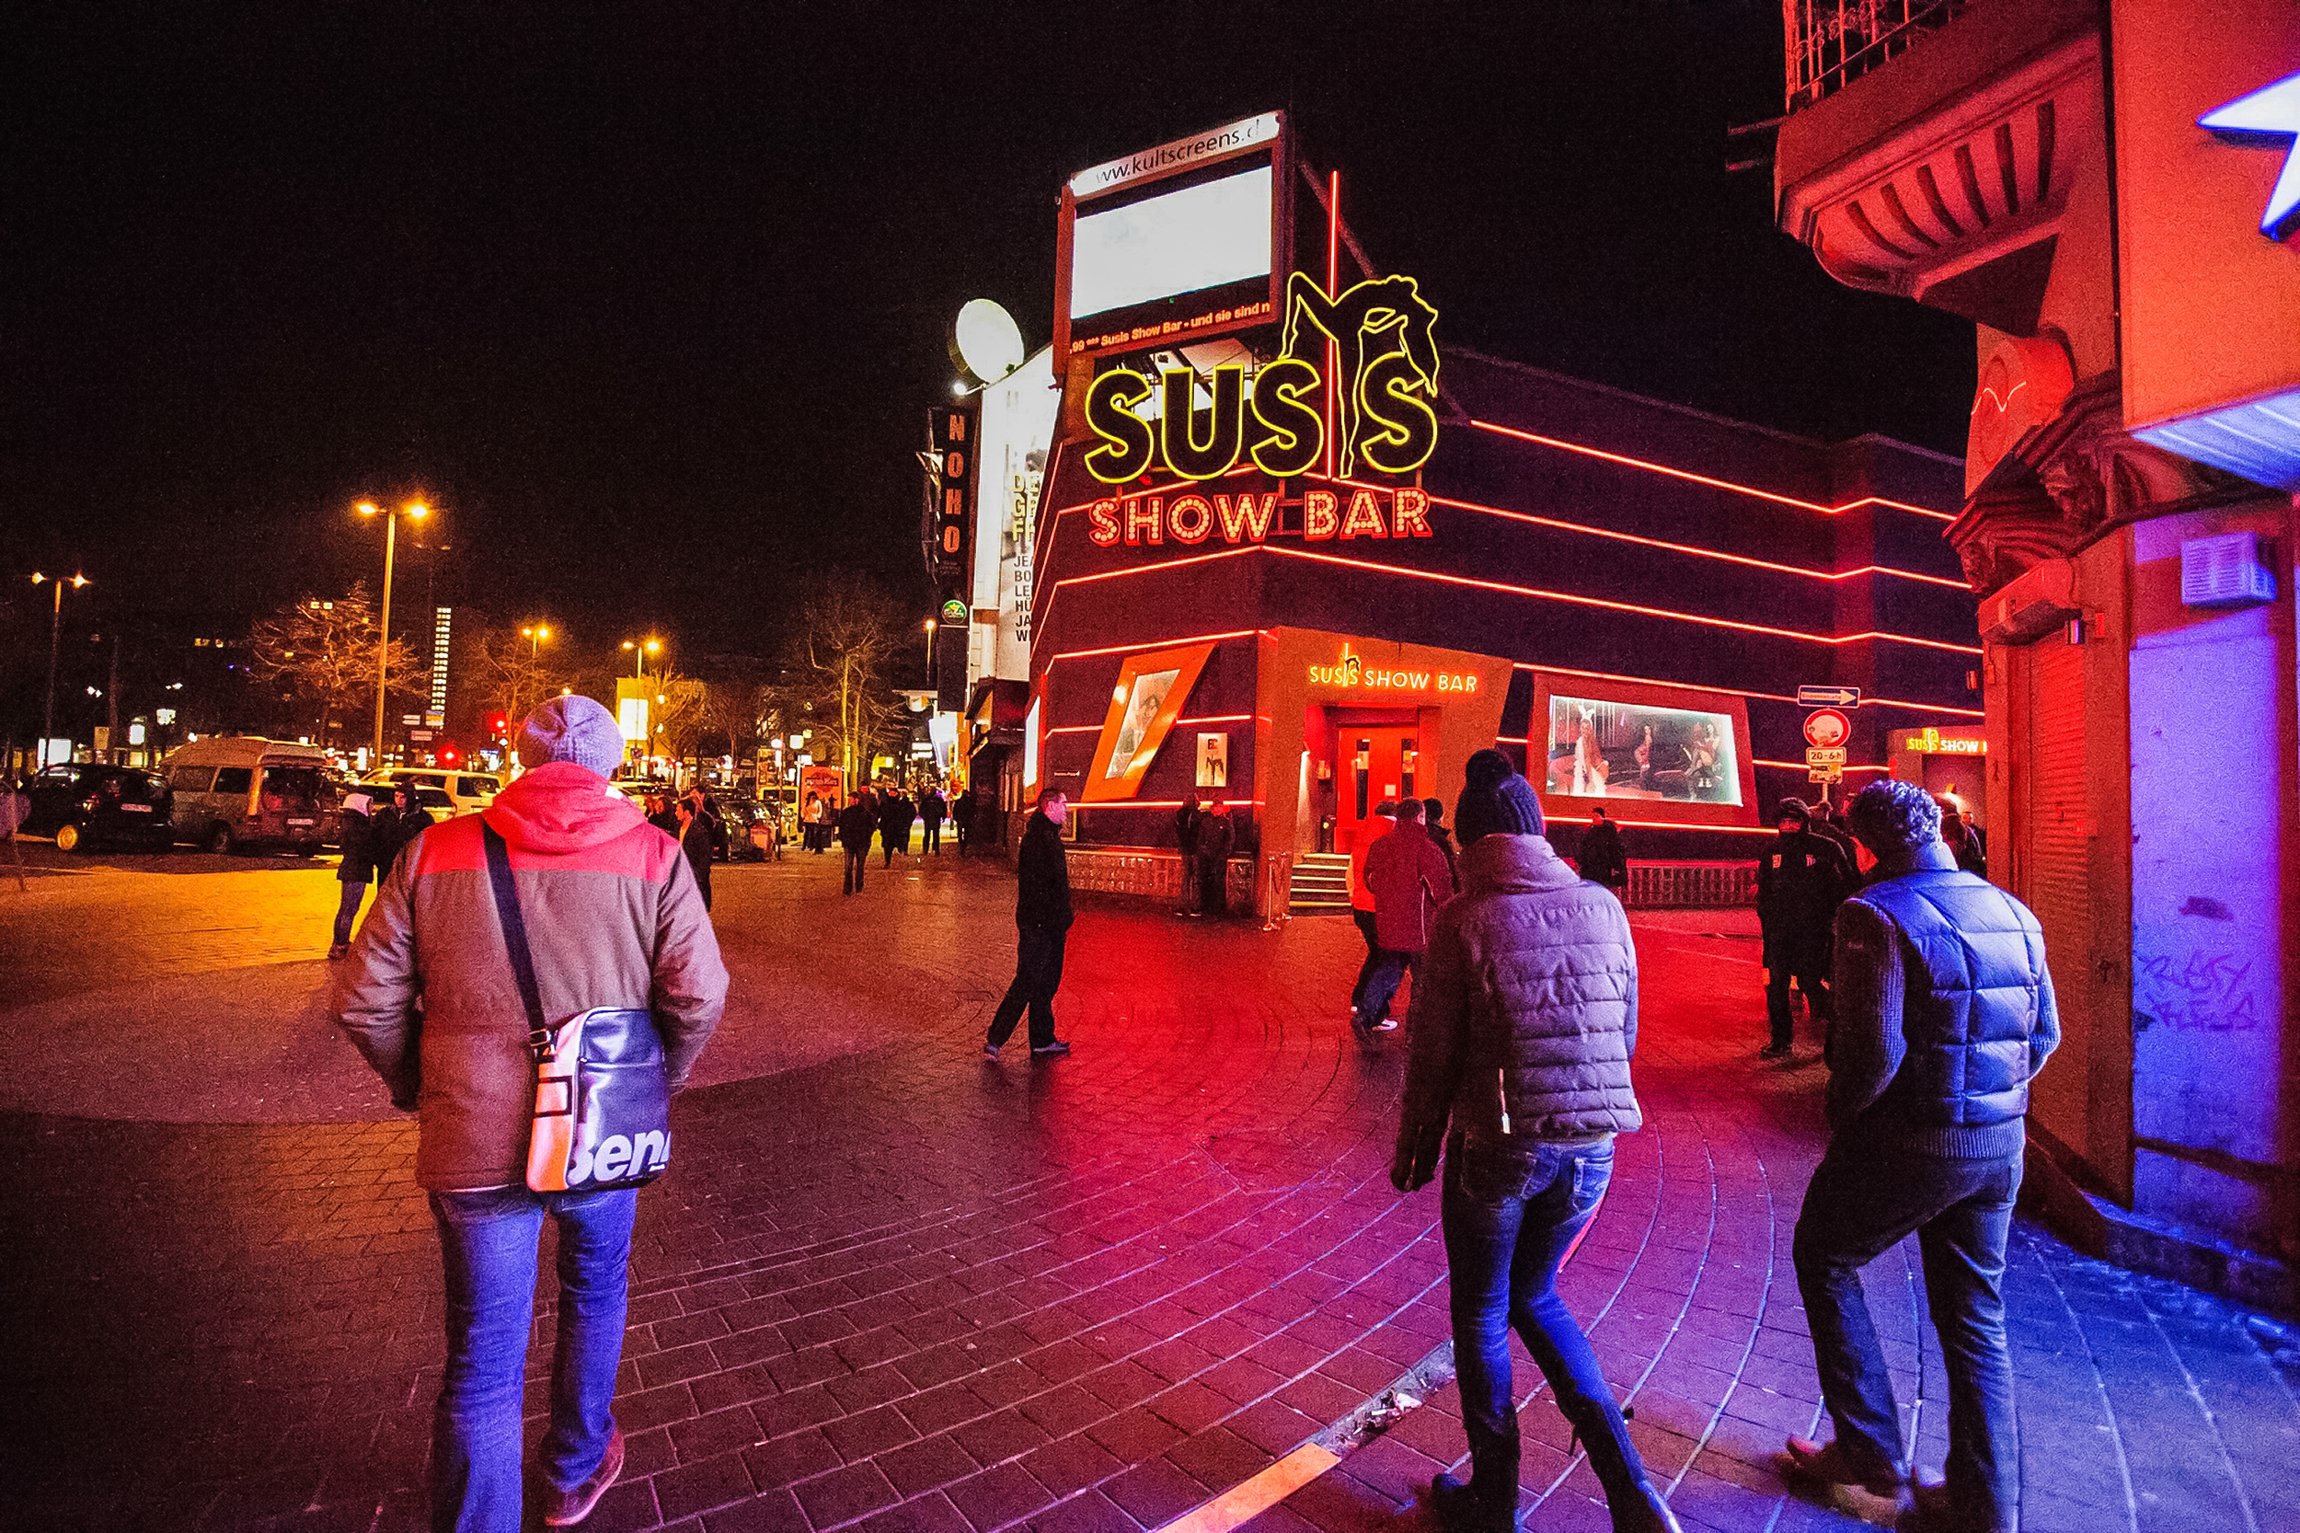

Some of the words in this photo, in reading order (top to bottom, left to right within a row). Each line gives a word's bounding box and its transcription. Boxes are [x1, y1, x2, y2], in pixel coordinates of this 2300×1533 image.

[1132, 323, 1161, 340] Show
[1163, 319, 1182, 334] Bar
[1191, 313, 1213, 327] und
[1215, 308, 1232, 323] sie
[1235, 301, 1260, 319] sind
[942, 413, 967, 554] NOHO
[1088, 492, 1279, 547] SHOW
[1303, 487, 1434, 542] BAR
[1364, 669, 1430, 690] SHOW
[1437, 673, 1478, 693] BAR
[1940, 739, 1979, 753] SHOW
